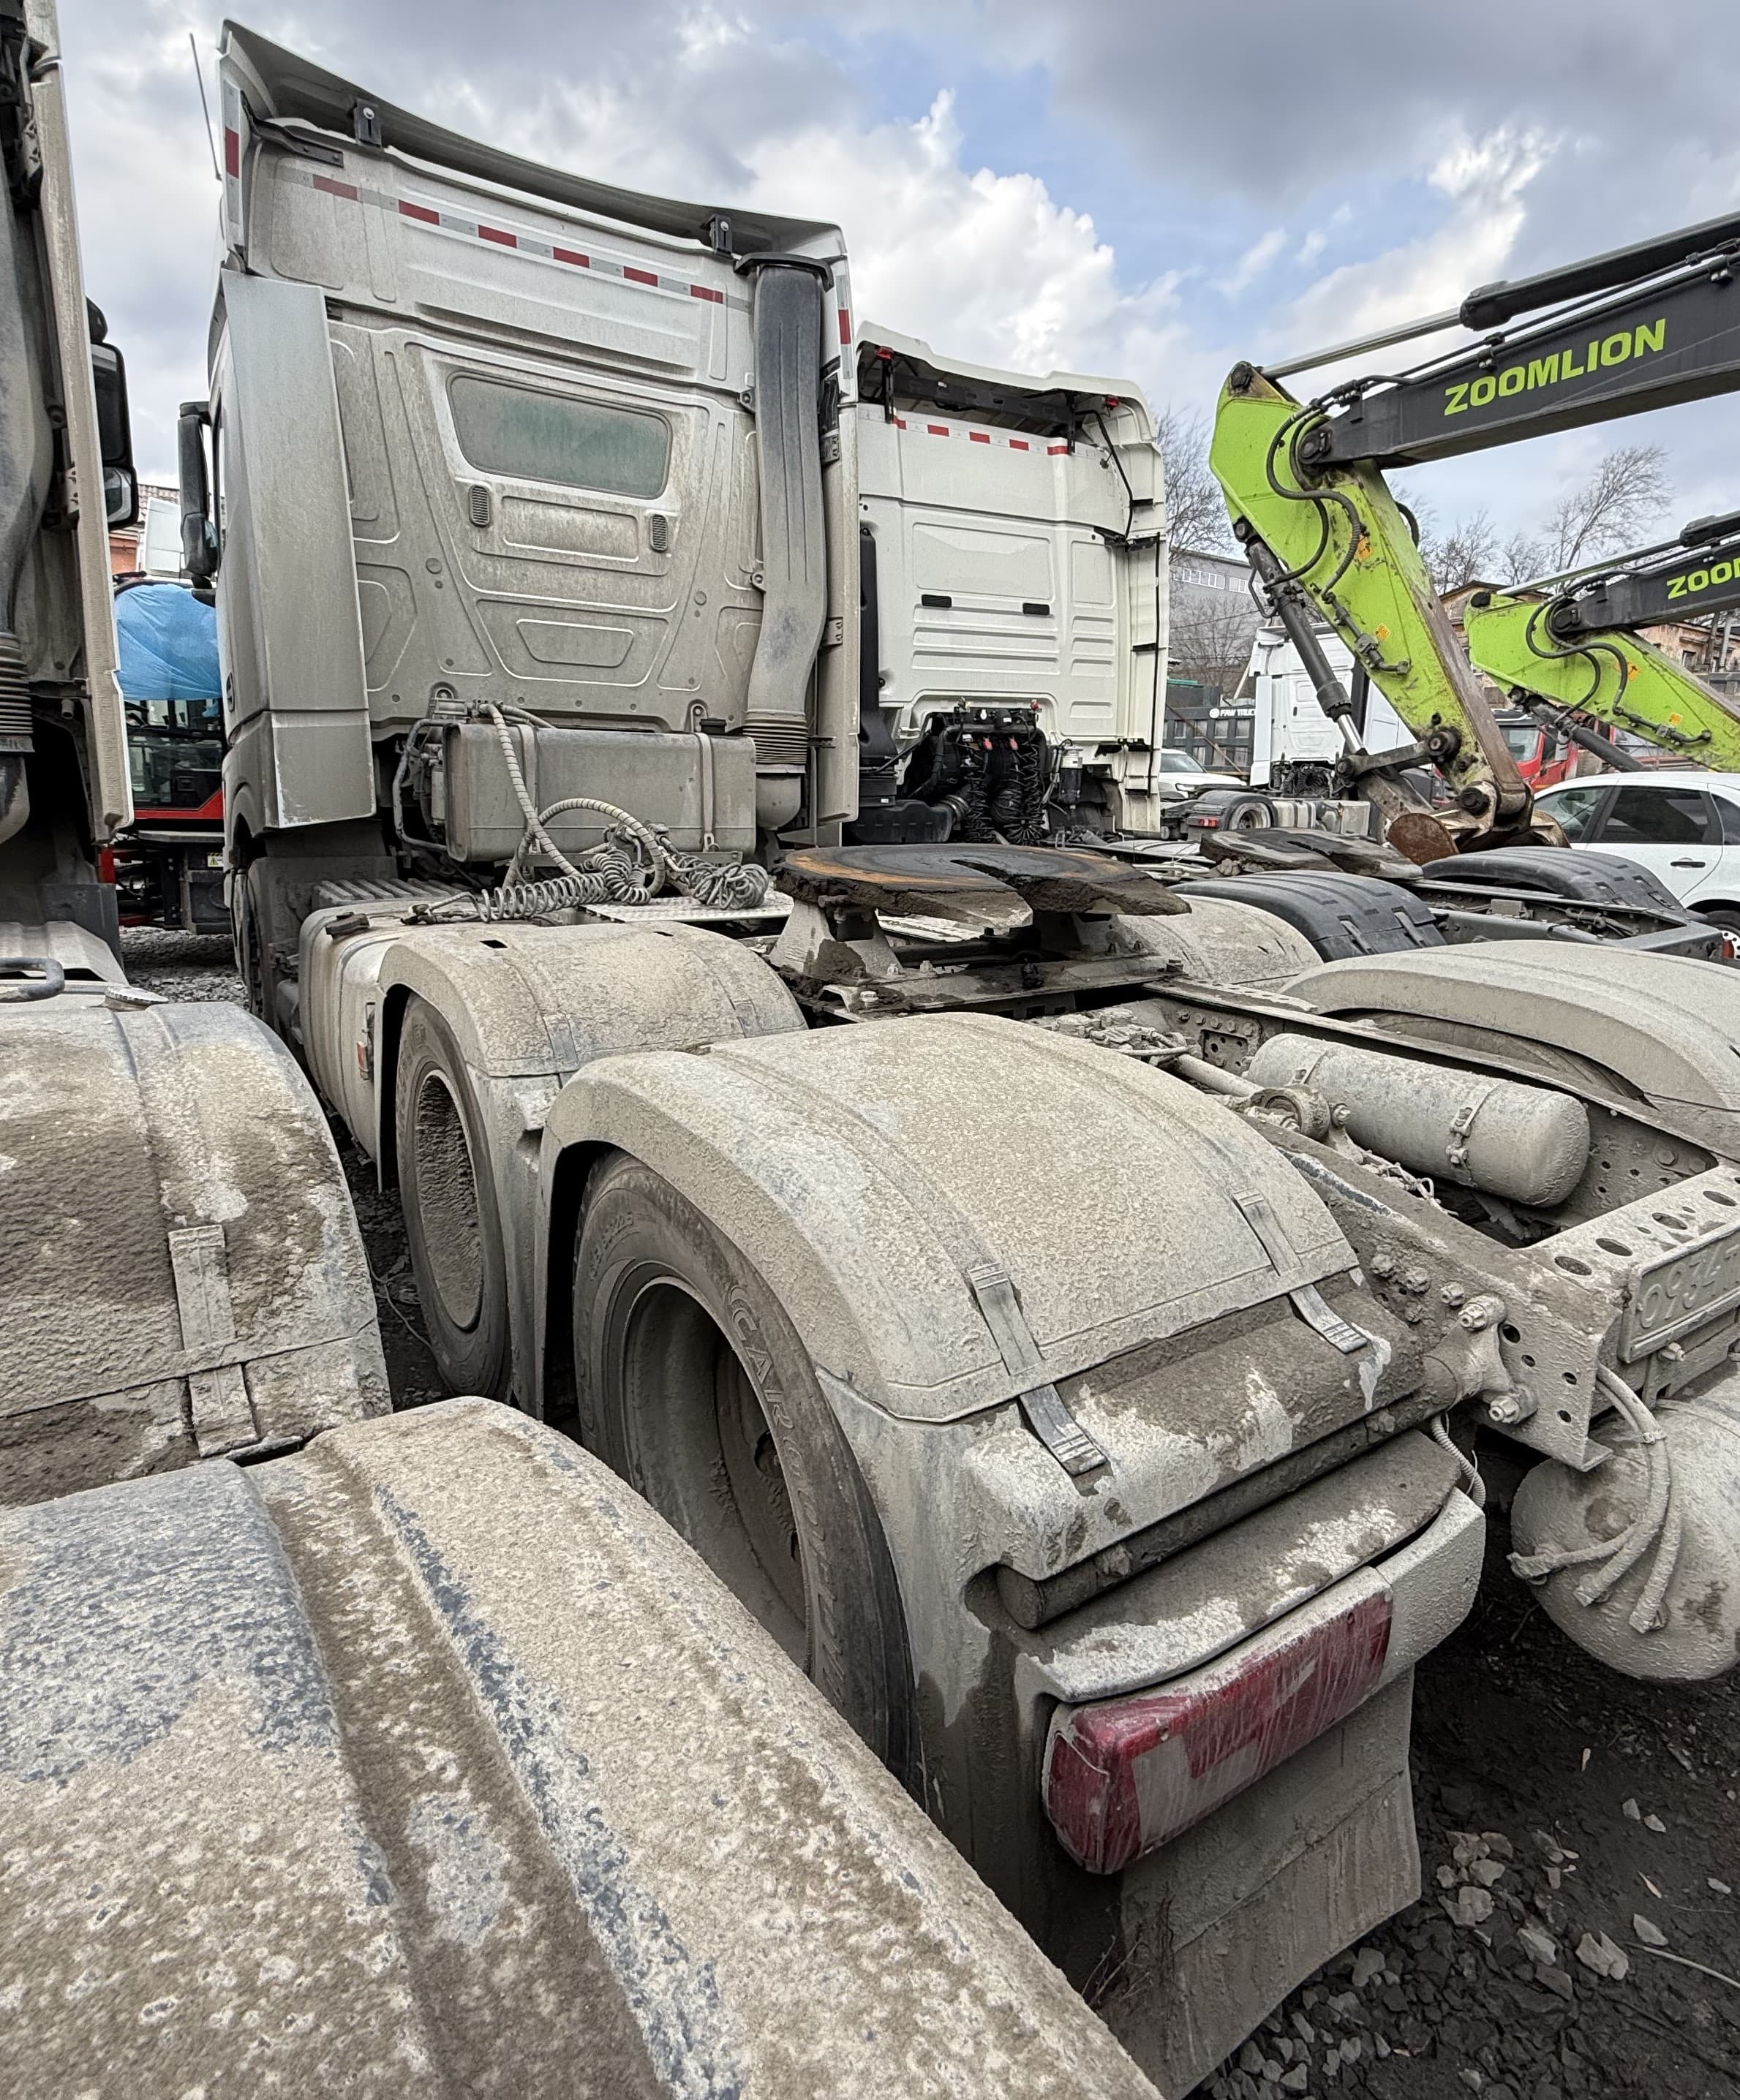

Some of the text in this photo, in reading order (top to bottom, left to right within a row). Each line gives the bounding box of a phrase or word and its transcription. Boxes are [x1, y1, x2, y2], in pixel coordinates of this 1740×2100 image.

[1444, 318, 1666, 416] ZOOMLION
[1220, 708, 1256, 717] FAW TRUC
